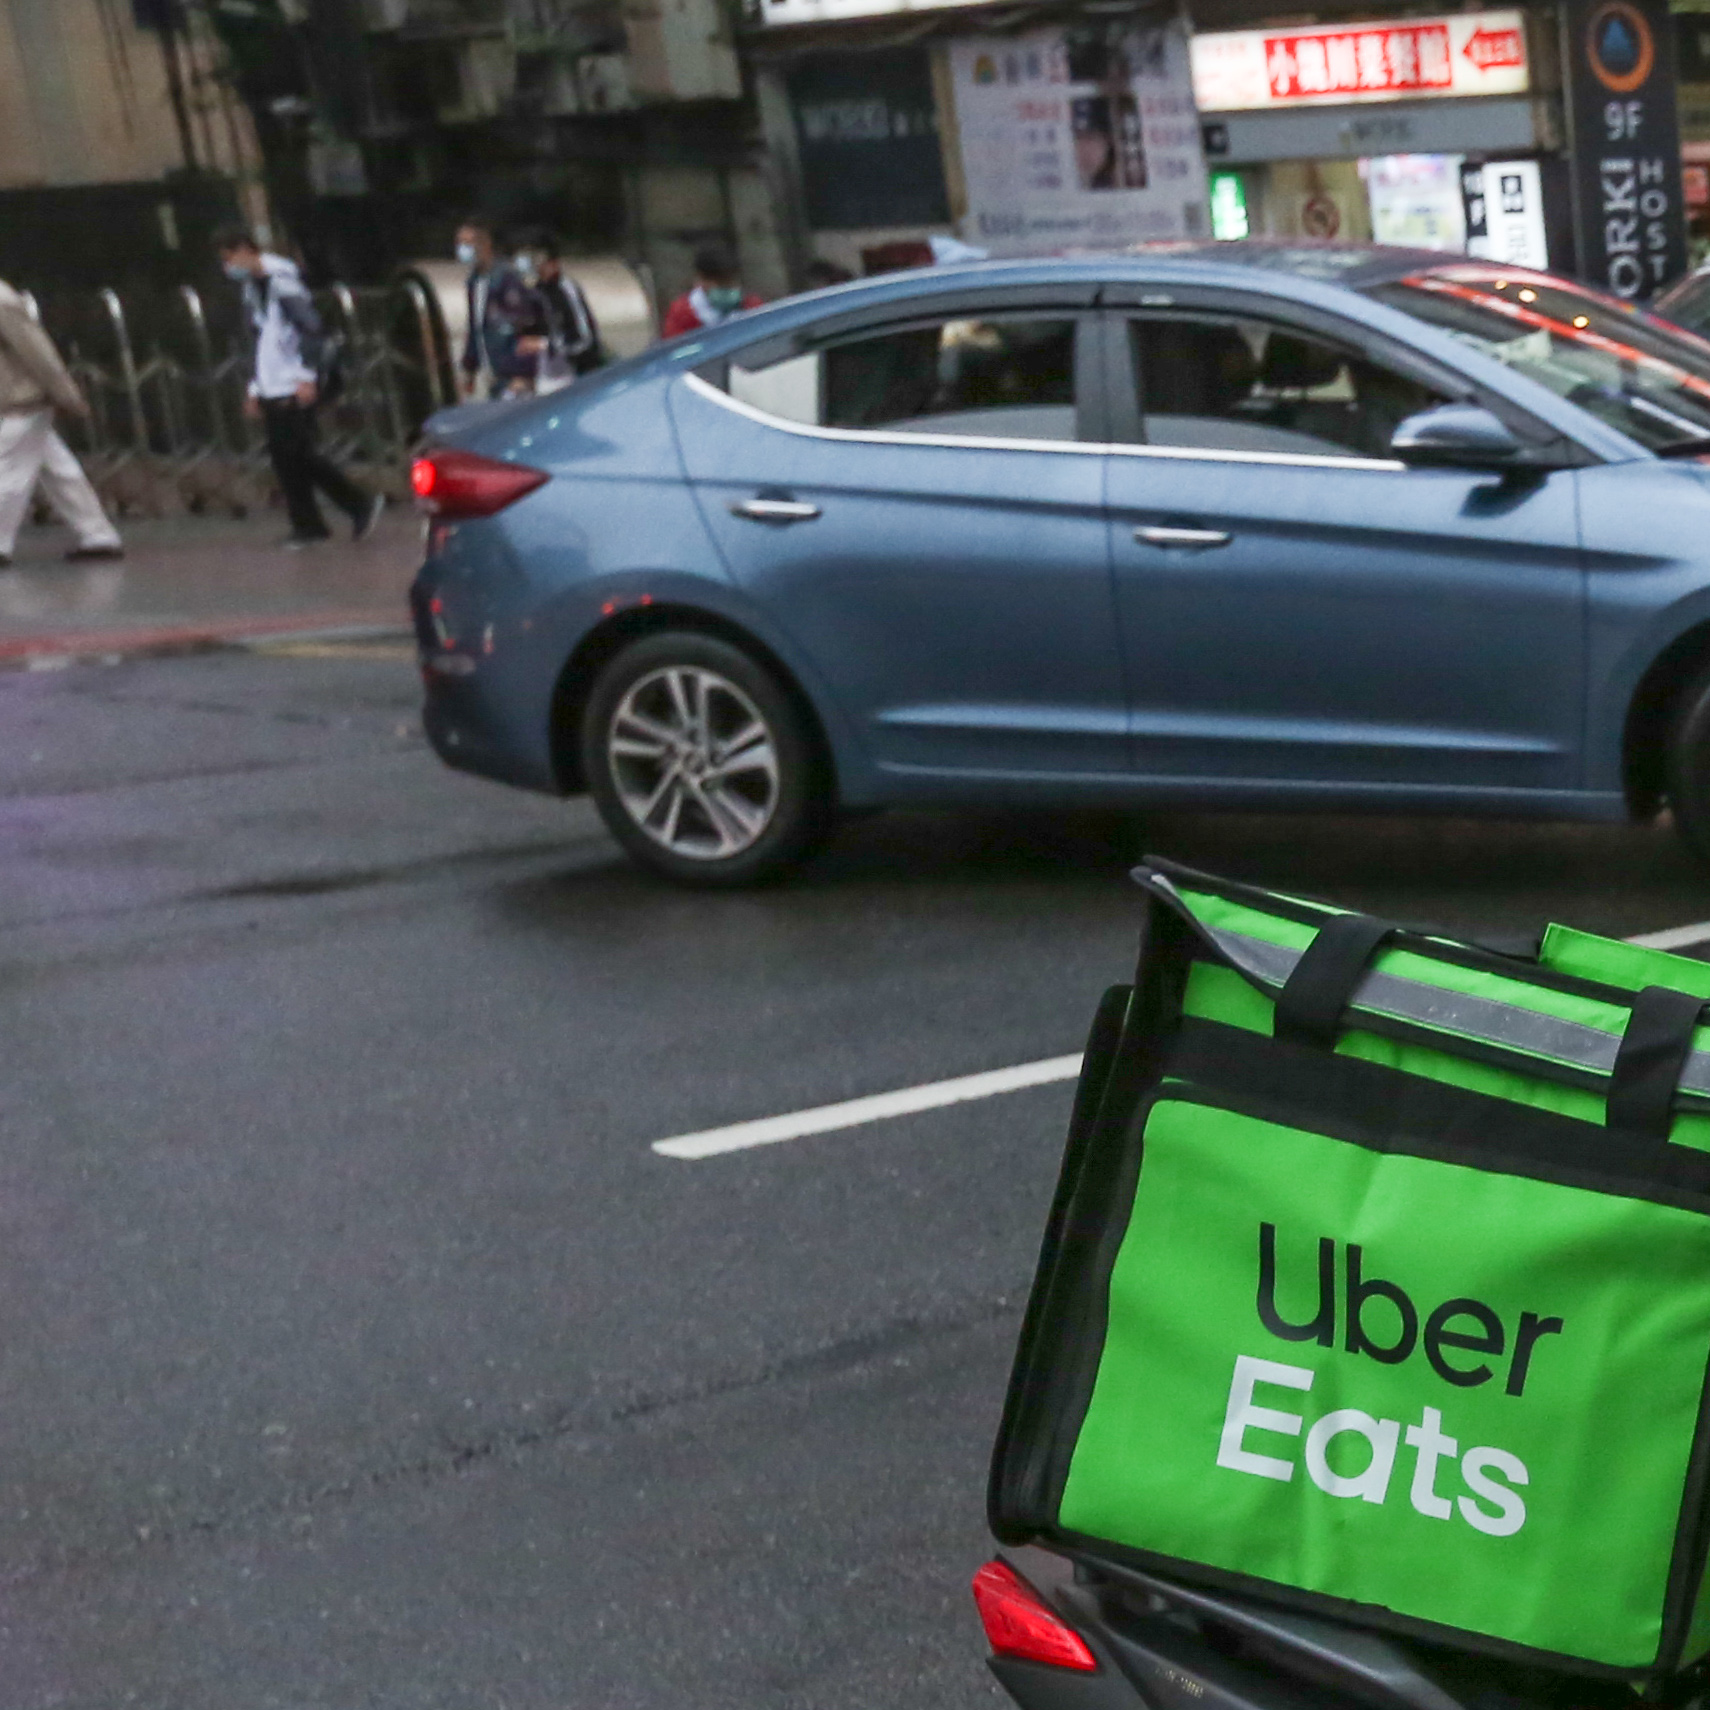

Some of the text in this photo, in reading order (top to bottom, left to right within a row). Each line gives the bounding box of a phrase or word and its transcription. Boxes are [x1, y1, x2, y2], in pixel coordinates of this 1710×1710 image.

[1603, 100, 1643, 141] 9F
[1638, 157, 1669, 284] HOST
[1256, 1222, 1563, 1397] Uber
[1216, 1355, 1531, 1538] Eats
